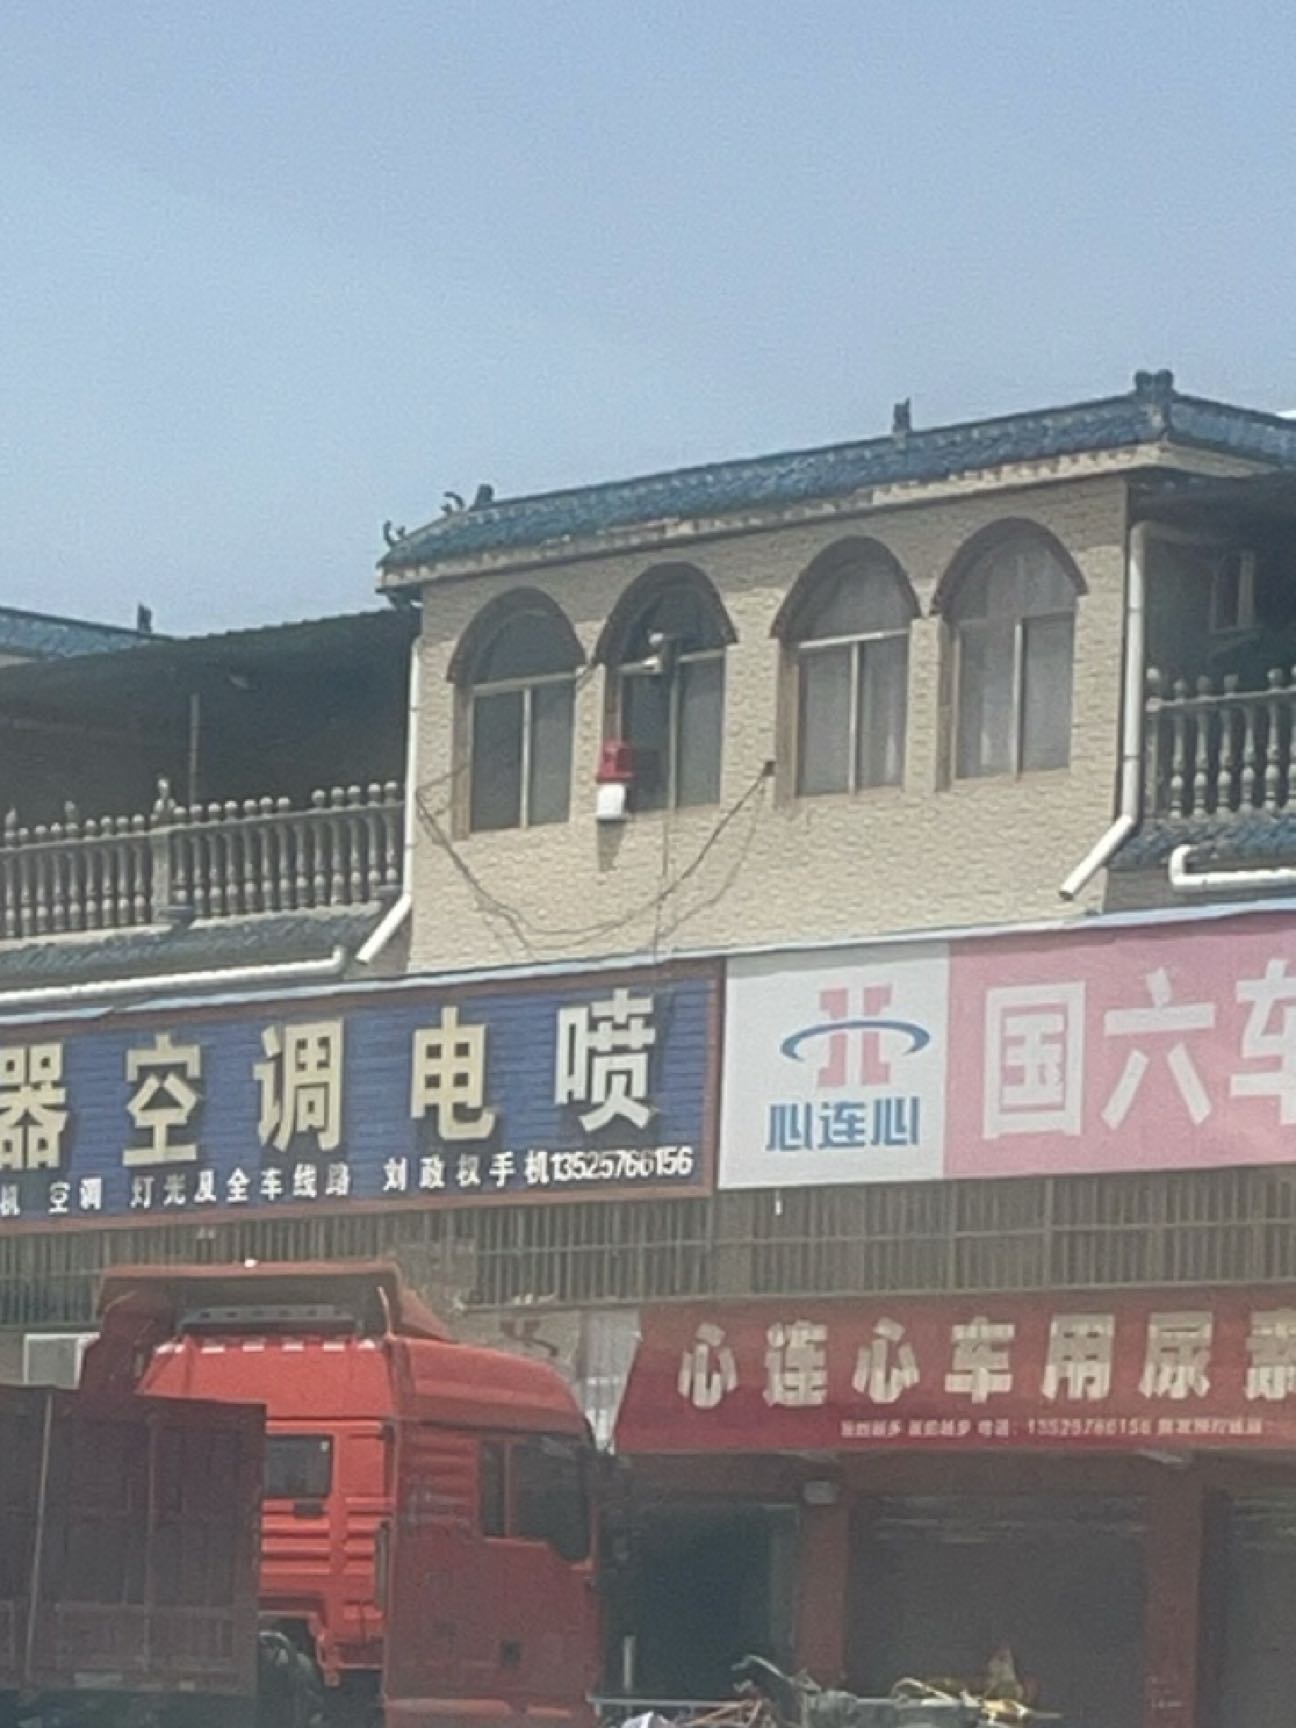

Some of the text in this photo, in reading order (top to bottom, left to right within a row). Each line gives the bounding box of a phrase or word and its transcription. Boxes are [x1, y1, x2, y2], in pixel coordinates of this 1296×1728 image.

[982, 958, 1296, 1140] 国六车
[765, 1097, 920, 1153] 心连心
[48, 1178, 102, 1214] 空调
[130, 1162, 351, 1209] 灯光及全车线路
[678, 1311, 1296, 1407] 心连心车用尿素
